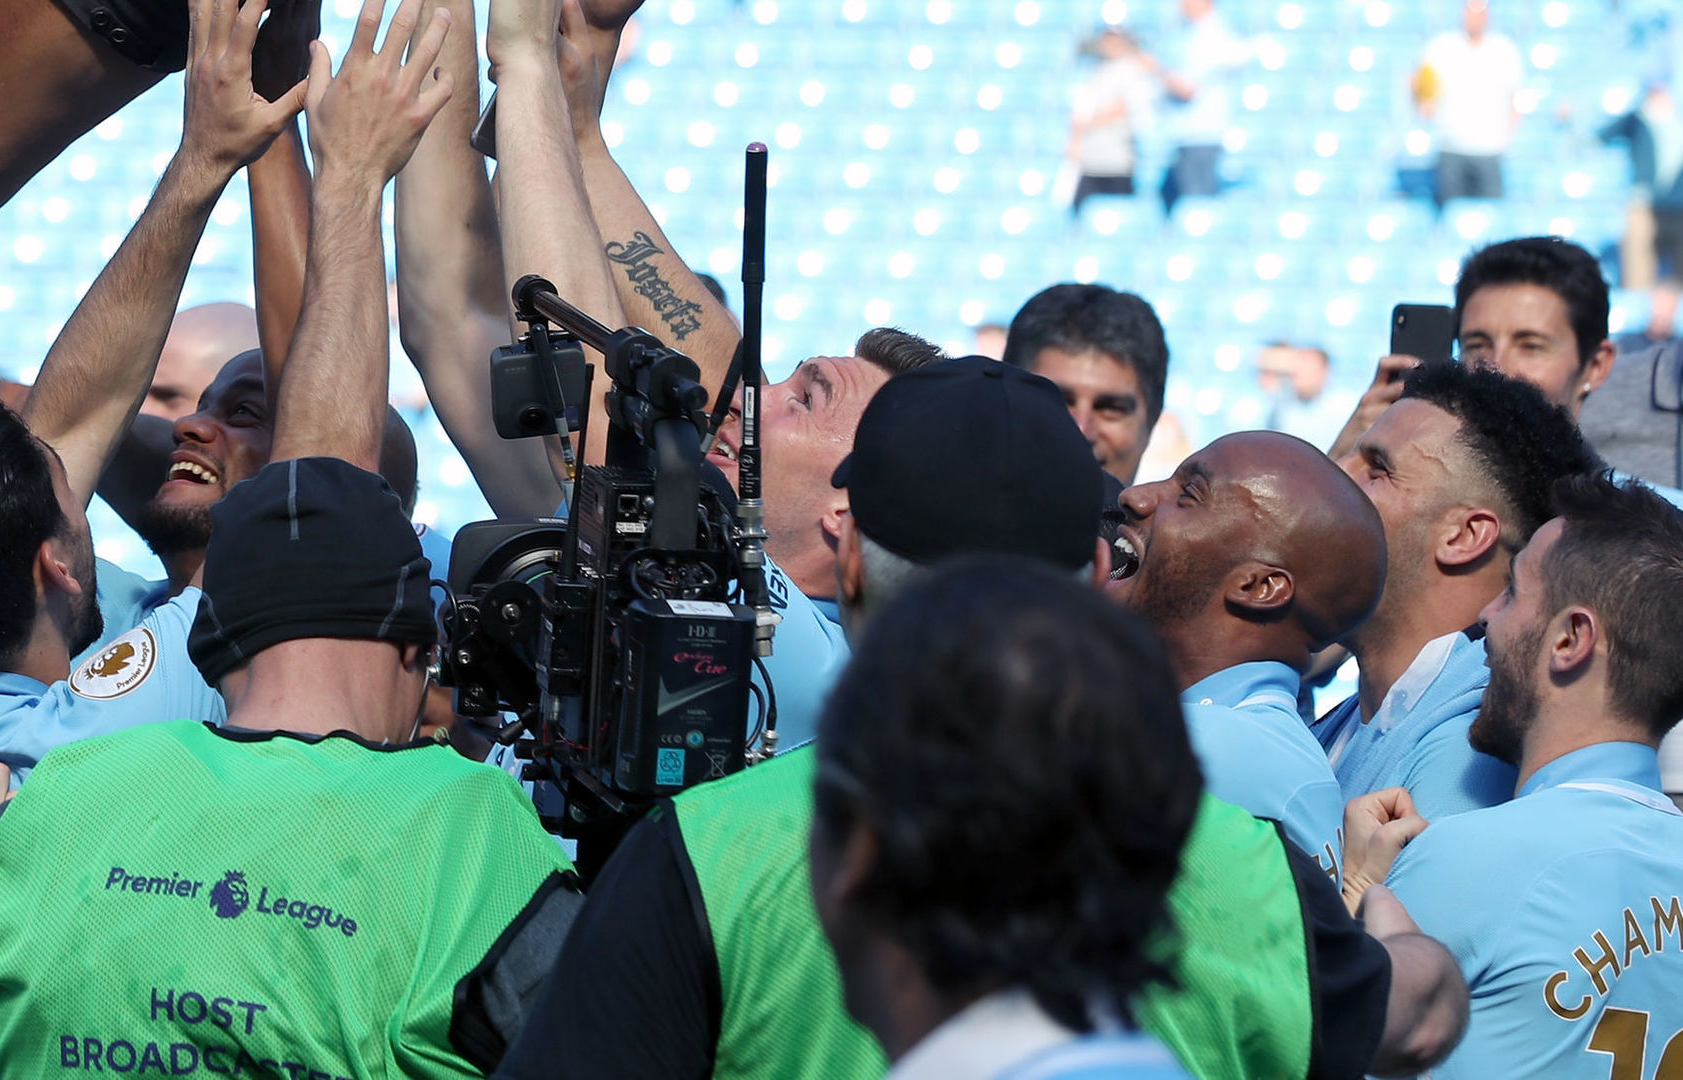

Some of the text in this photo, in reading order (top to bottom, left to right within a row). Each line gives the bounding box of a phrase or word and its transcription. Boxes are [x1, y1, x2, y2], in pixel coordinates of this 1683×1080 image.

[116, 641, 151, 690] Premier League
[105, 866, 358, 937] Premier League
[150, 986, 268, 1036] HOST
[60, 1034, 353, 1080] BROADCASTE
